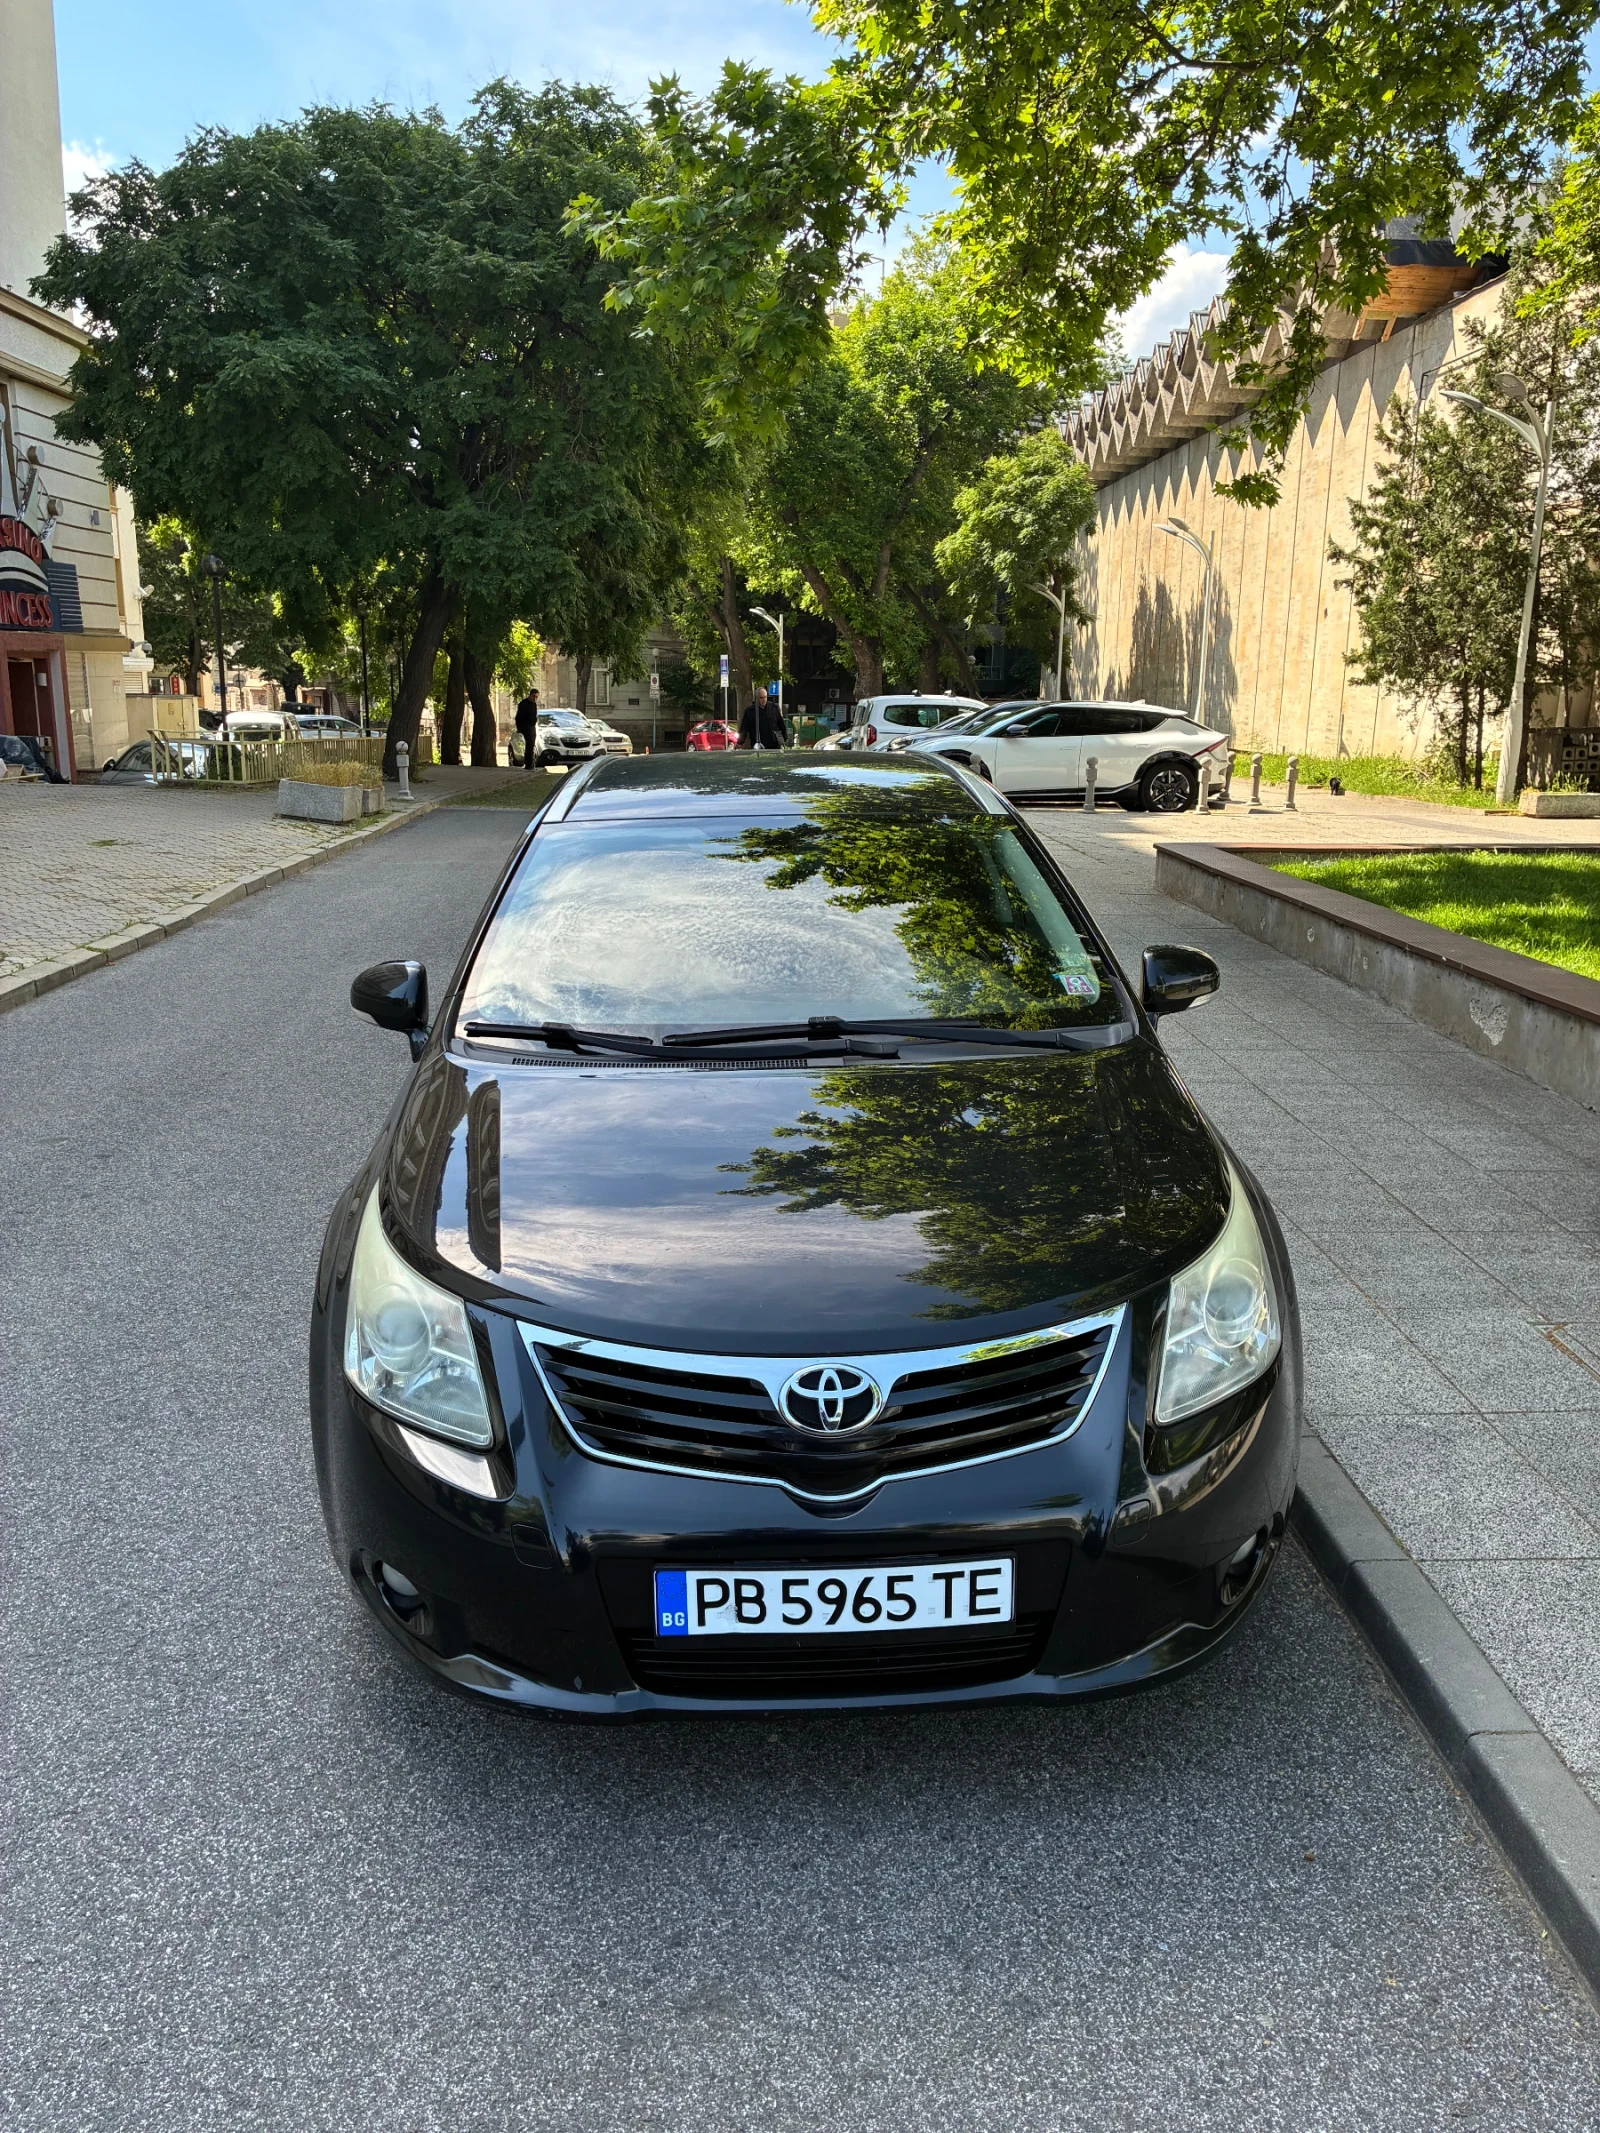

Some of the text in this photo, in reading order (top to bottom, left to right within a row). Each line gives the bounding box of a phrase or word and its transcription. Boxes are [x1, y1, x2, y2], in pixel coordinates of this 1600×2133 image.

[696, 1567, 1002, 1627] PB 5965 TE
[662, 1612, 685, 1627] BG
